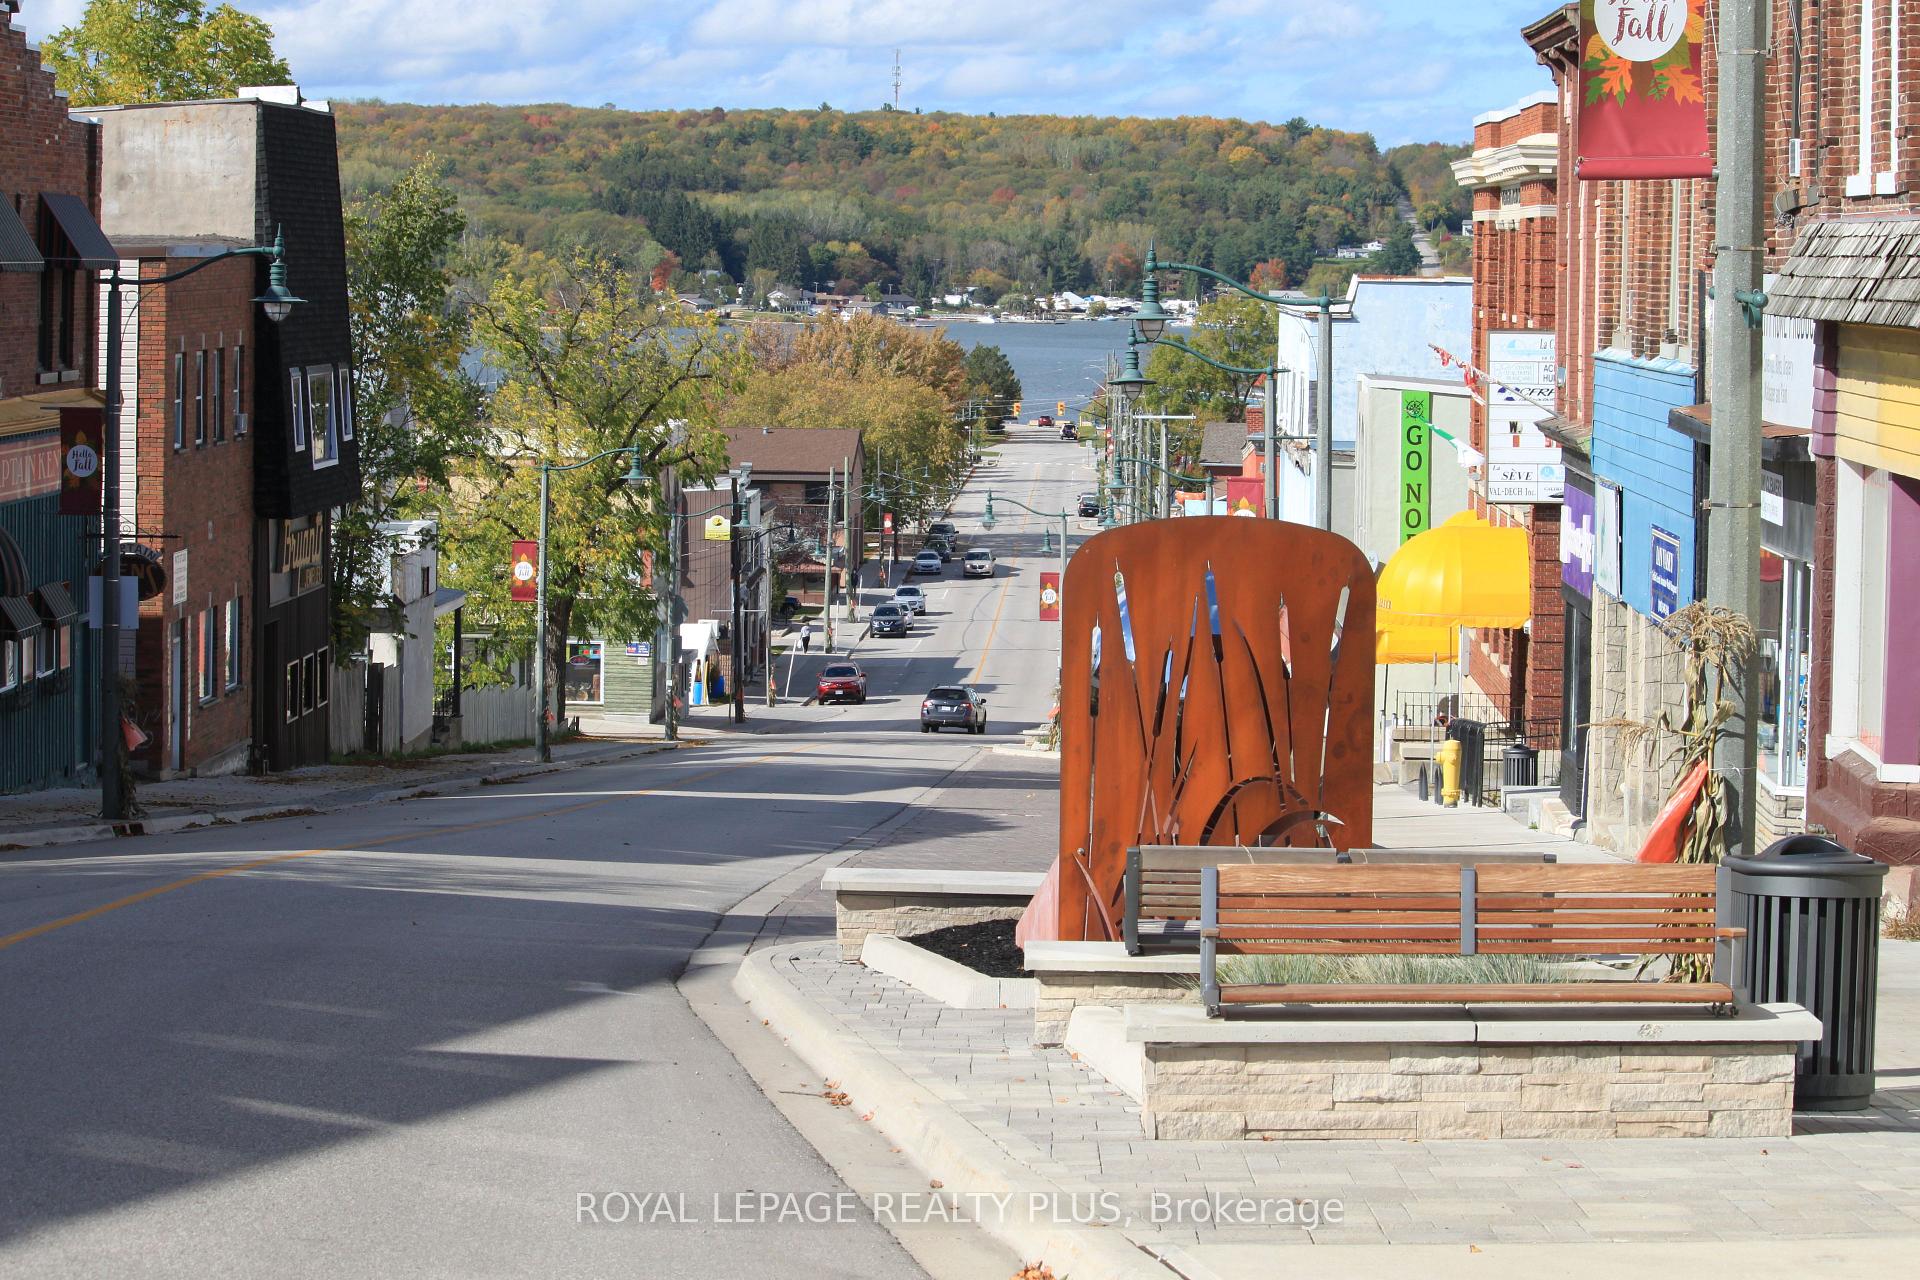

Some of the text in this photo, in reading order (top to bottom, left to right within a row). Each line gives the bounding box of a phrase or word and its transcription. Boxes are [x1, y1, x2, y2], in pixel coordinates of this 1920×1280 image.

[1612, 4, 1674, 46] Fall
[72, 449, 93, 459] Hello
[0, 454, 37, 488] PTAIN
[73, 458, 93, 472] Fall
[1501, 468, 1533, 481] SÈVE
[1489, 486, 1523, 496] VAL-DECH
